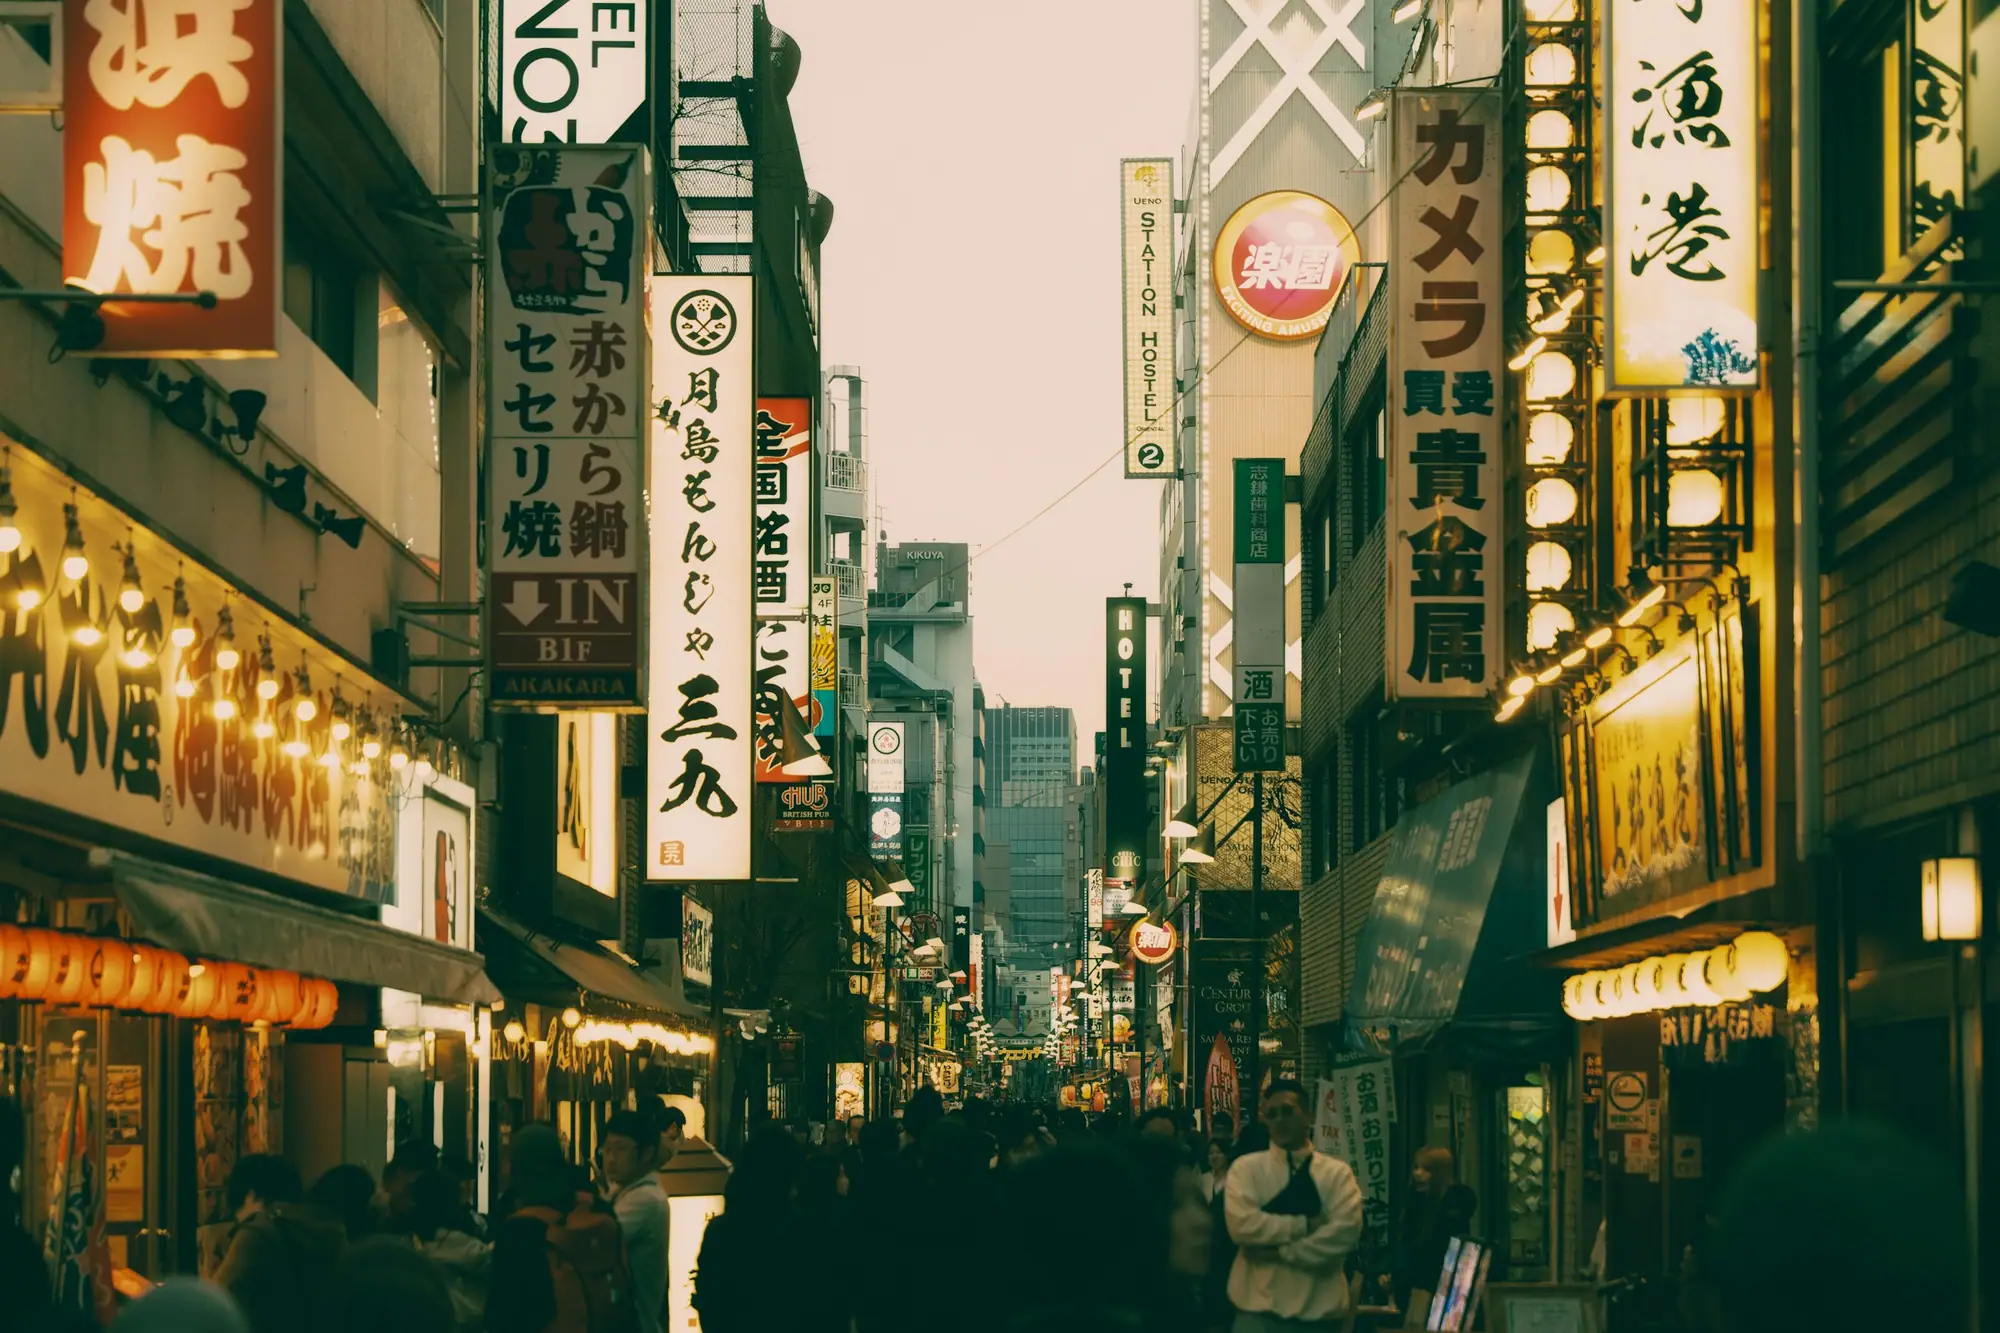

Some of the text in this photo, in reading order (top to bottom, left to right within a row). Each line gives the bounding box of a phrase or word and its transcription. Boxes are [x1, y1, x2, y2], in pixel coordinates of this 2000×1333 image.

[1413, 108, 1487, 359] カメラ
[1238, 241, 1339, 290] 楽園
[1141, 212, 1158, 422] STATION HOSTEL
[502, 323, 562, 559] セセリ焼
[568, 320, 628, 559] 赤から鍋
[1142, 445, 1160, 465] 2
[906, 551, 945, 560] KIKUYA
[1407, 428, 1487, 684] 貴金属
[555, 578, 628, 625] IN
[537, 638, 592, 664] B1F
[504, 676, 626, 695] AKAKARA
[1117, 609, 1134, 748] HOTEL
[1243, 670, 1273, 700] 酒
[781, 784, 829, 811] HUB
[1321, 1124, 1340, 1139] TAX
